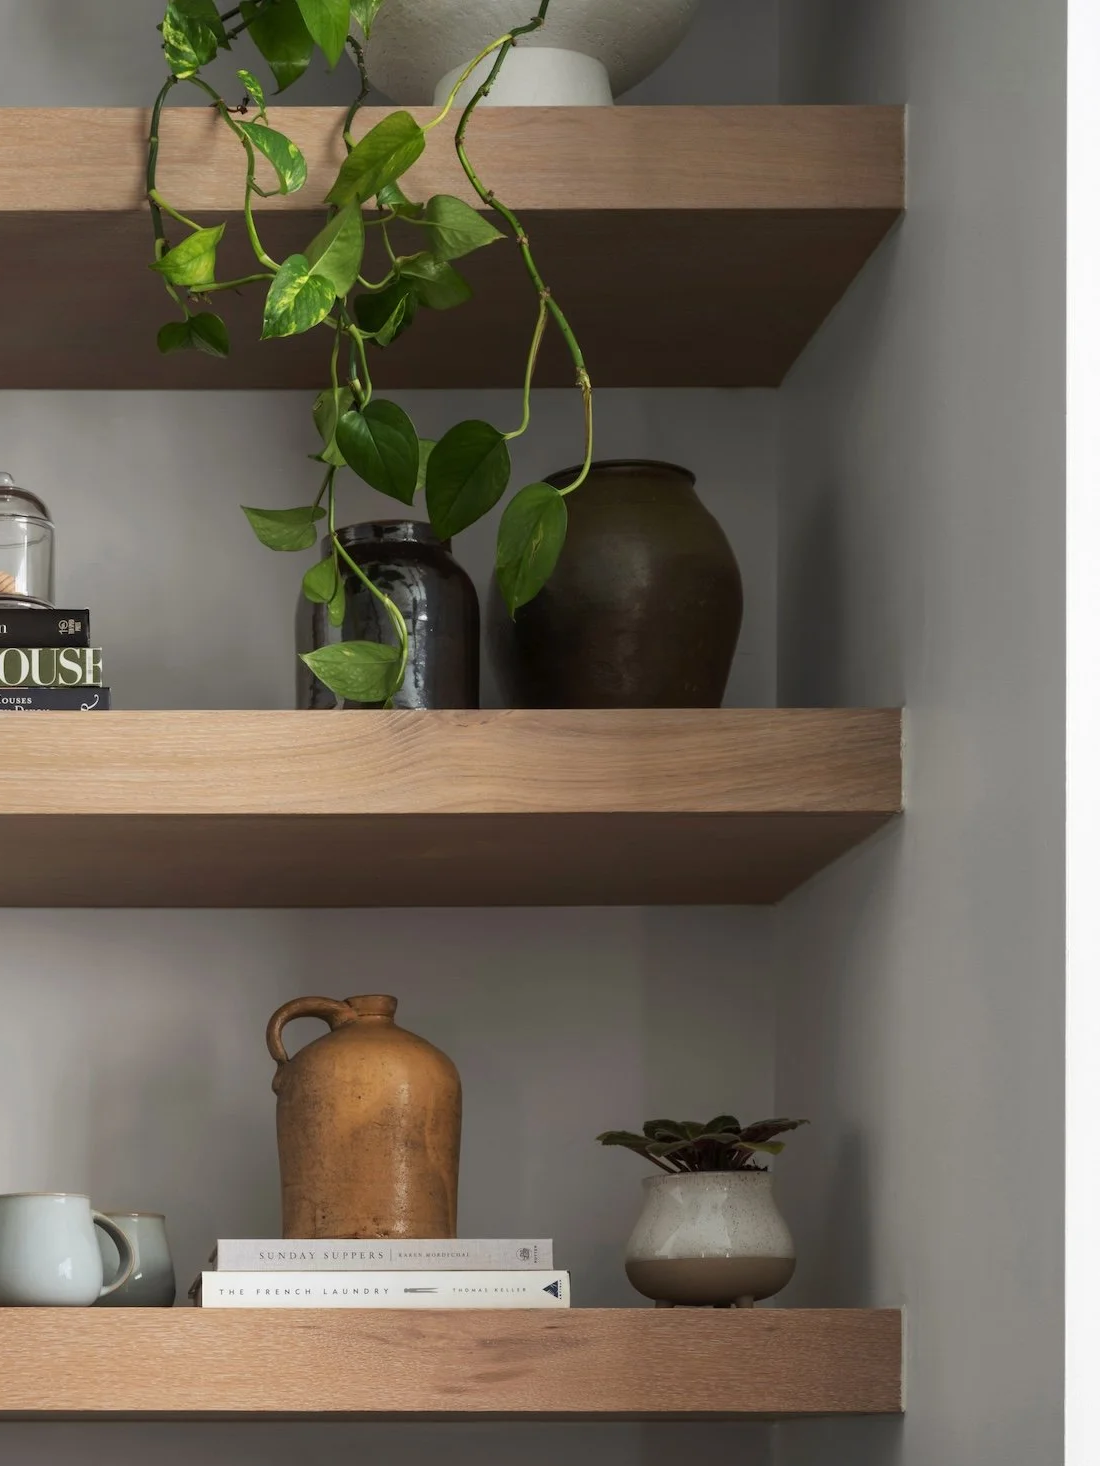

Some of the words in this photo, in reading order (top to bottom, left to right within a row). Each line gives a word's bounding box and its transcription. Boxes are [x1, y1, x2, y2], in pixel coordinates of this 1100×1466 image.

[259, 1251, 316, 1260] SUNDAY
[323, 1251, 384, 1260] SUPPERS
[219, 1288, 245, 1296] THE
[256, 1288, 311, 1296] FRENCH
[323, 1288, 390, 1296] LAUNDRY
